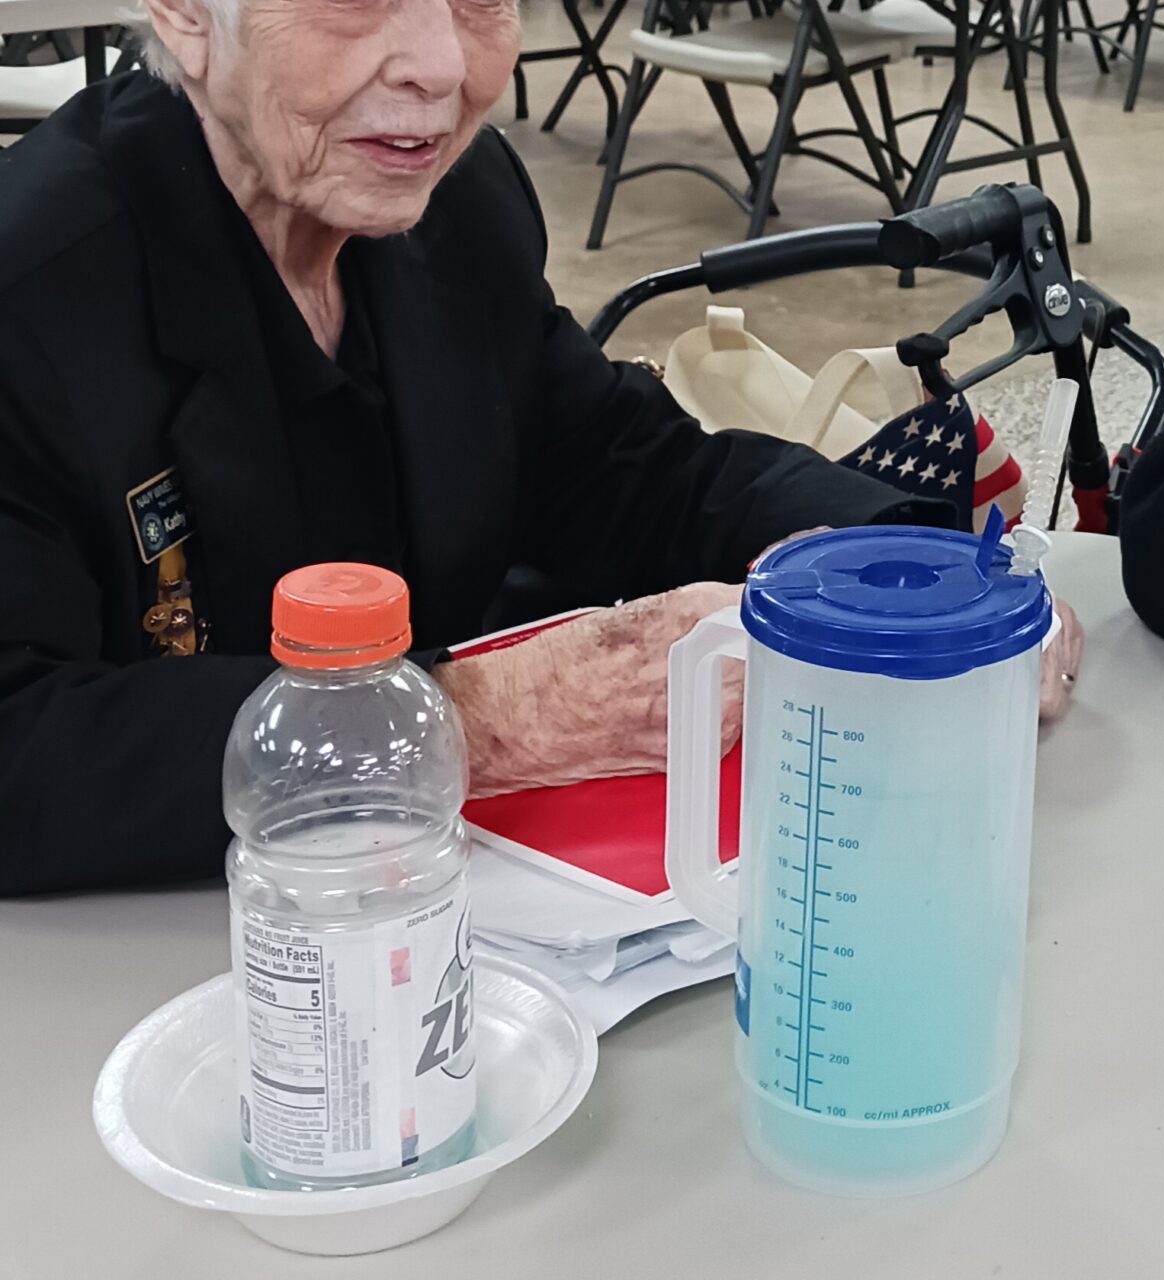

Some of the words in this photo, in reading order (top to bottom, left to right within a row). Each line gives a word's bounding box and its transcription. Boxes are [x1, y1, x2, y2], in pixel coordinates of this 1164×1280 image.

[781, 729, 793, 742] 26
[843, 730, 865, 743] 800
[780, 761, 792, 773] 24
[841, 784, 862, 797] 700
[779, 792, 790, 805] 22
[778, 825, 789, 838] 20
[838, 837, 859, 851] 600
[777, 856, 788, 869] 18
[776, 887, 787, 899] 16
[836, 891, 857, 904] 500
[407, 913, 428, 928] ZERO
[775, 918, 785, 931] 14
[244, 932, 284, 959] Nutrition
[286, 946, 319, 962] Facts
[833, 946, 854, 959] 400
[774, 950, 785, 963] 12
[773, 982, 783, 996] 10
[311, 989, 320, 1007] 5
[831, 999, 852, 1013] 300
[829, 1053, 850, 1066] 200
[826, 1104, 847, 1118] 100
[864, 1109, 899, 1120] cc/ml
